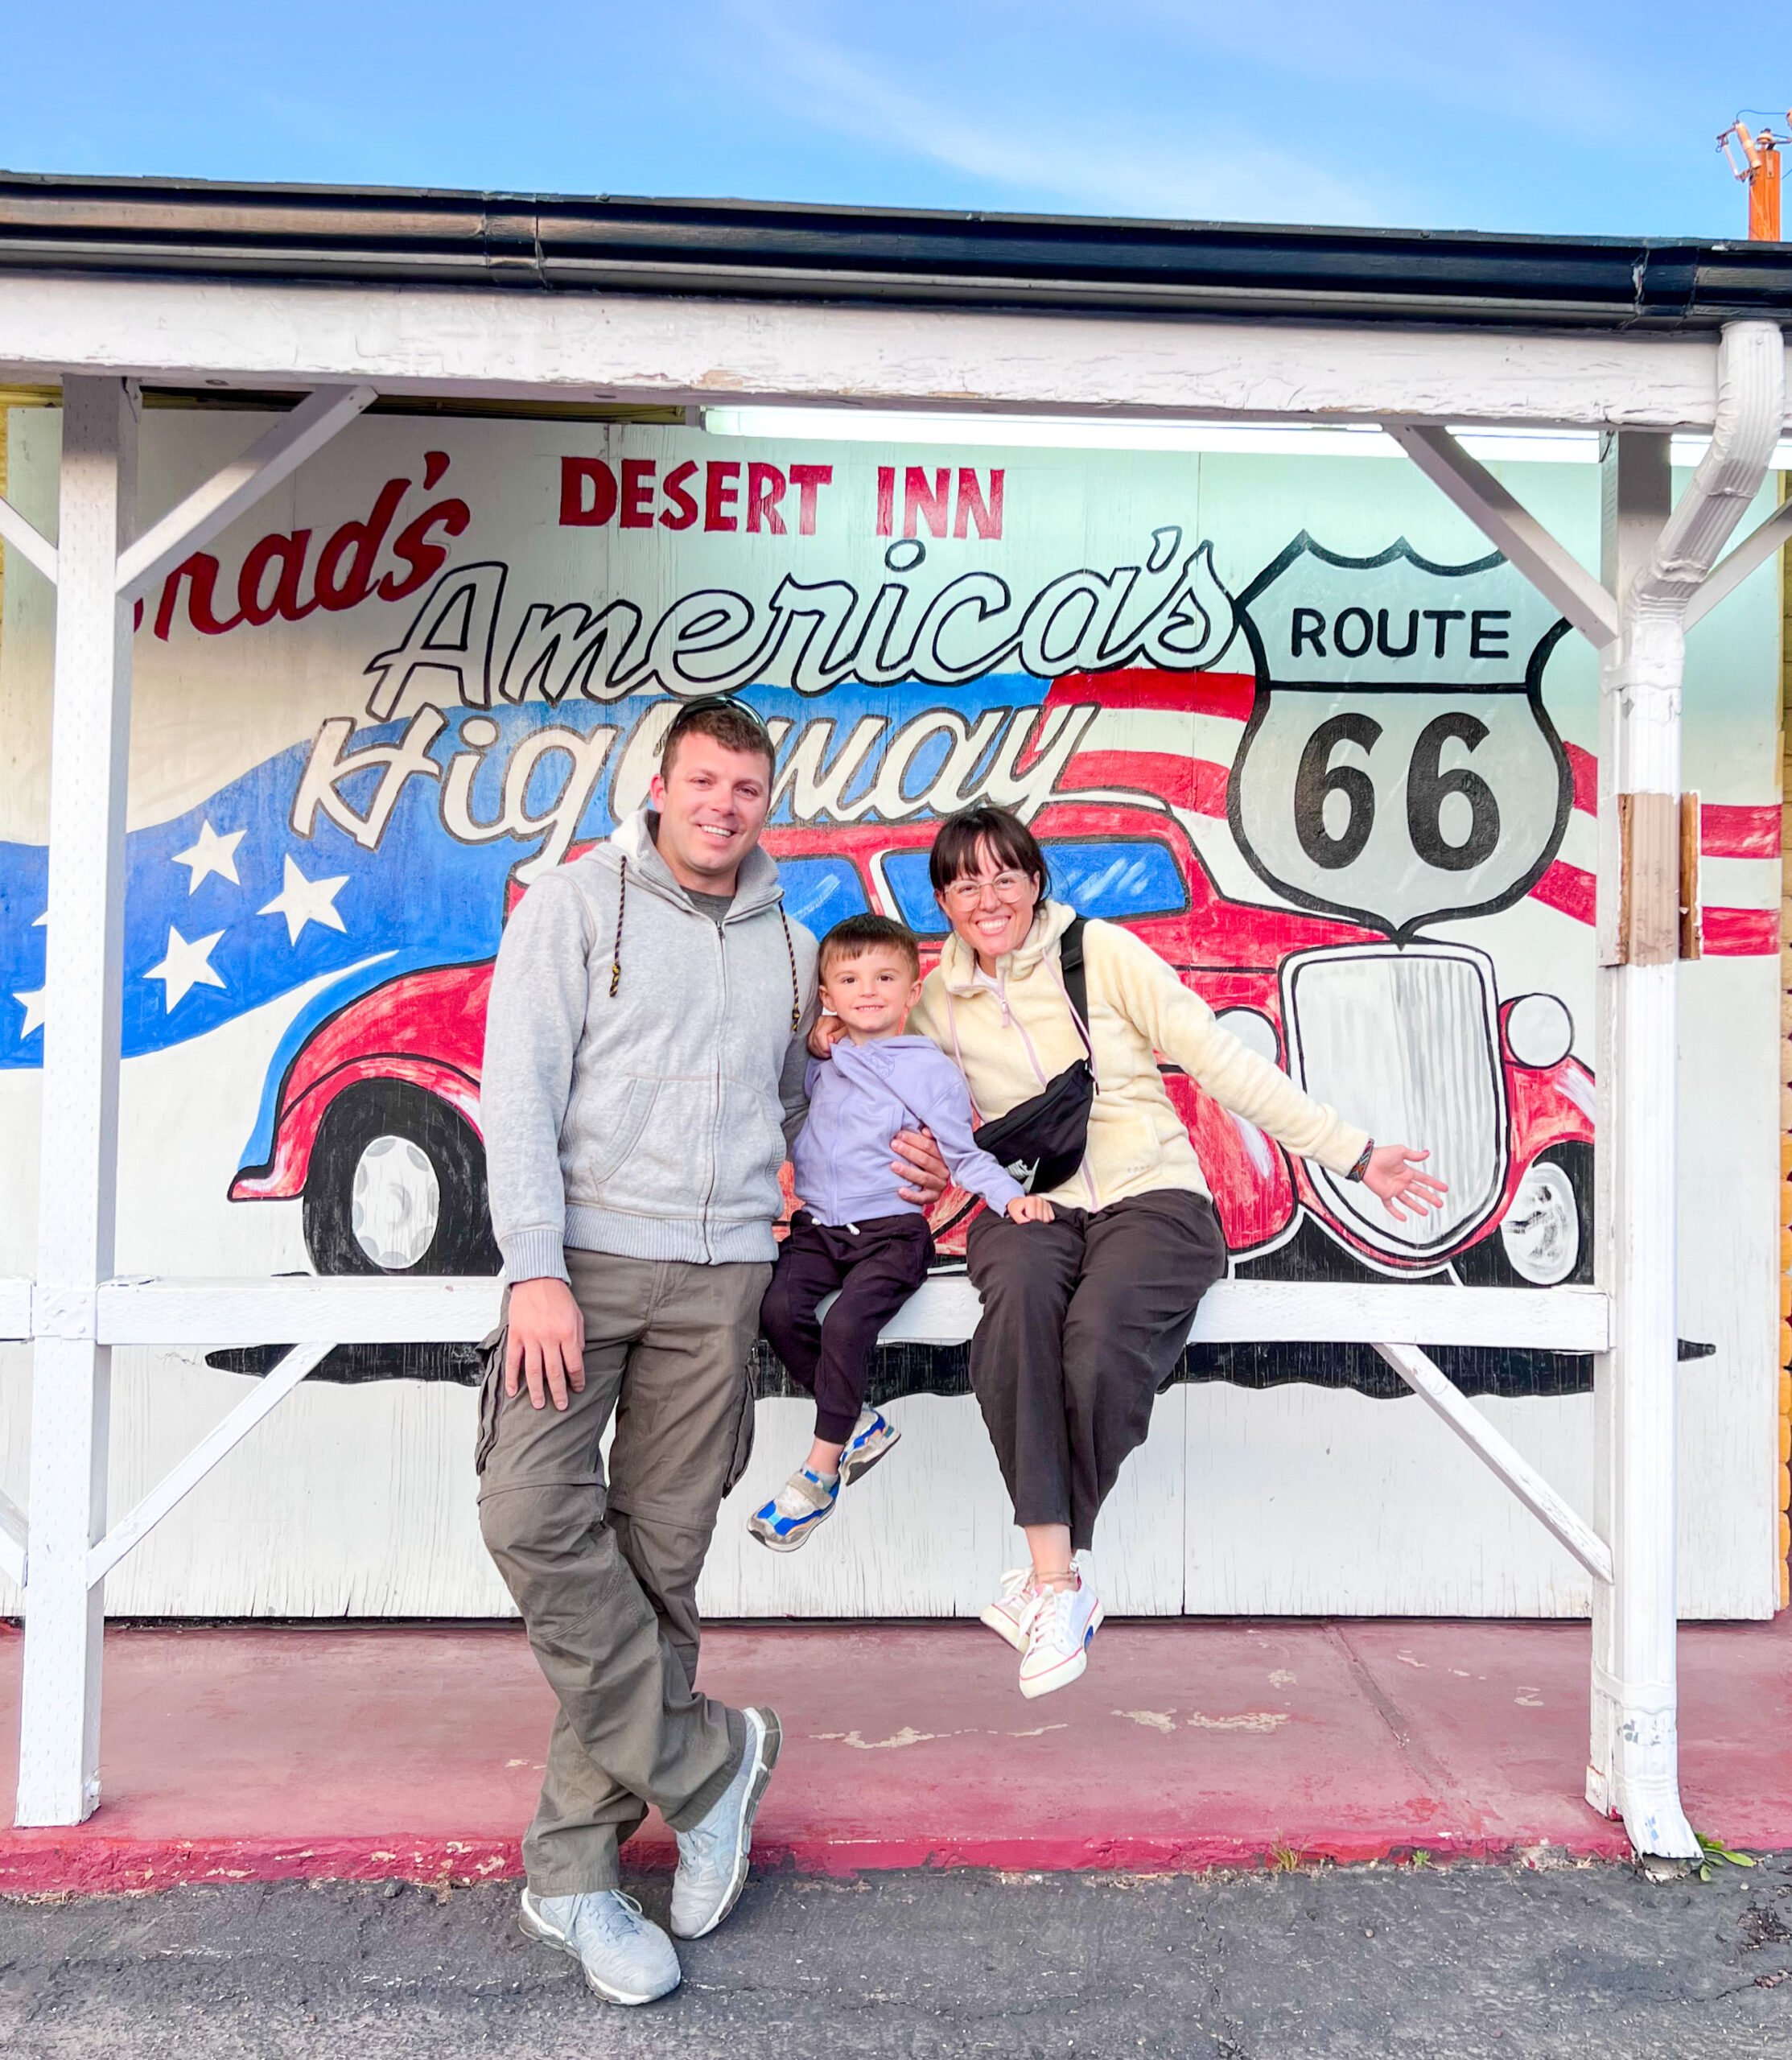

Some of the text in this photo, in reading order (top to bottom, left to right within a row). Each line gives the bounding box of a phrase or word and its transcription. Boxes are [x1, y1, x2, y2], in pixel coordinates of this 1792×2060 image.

[559, 456, 1005, 540] DESERT INN
[364, 525, 1239, 722] America's
[1291, 608, 1511, 658] ROUTE
[1294, 712, 1502, 871] 66
